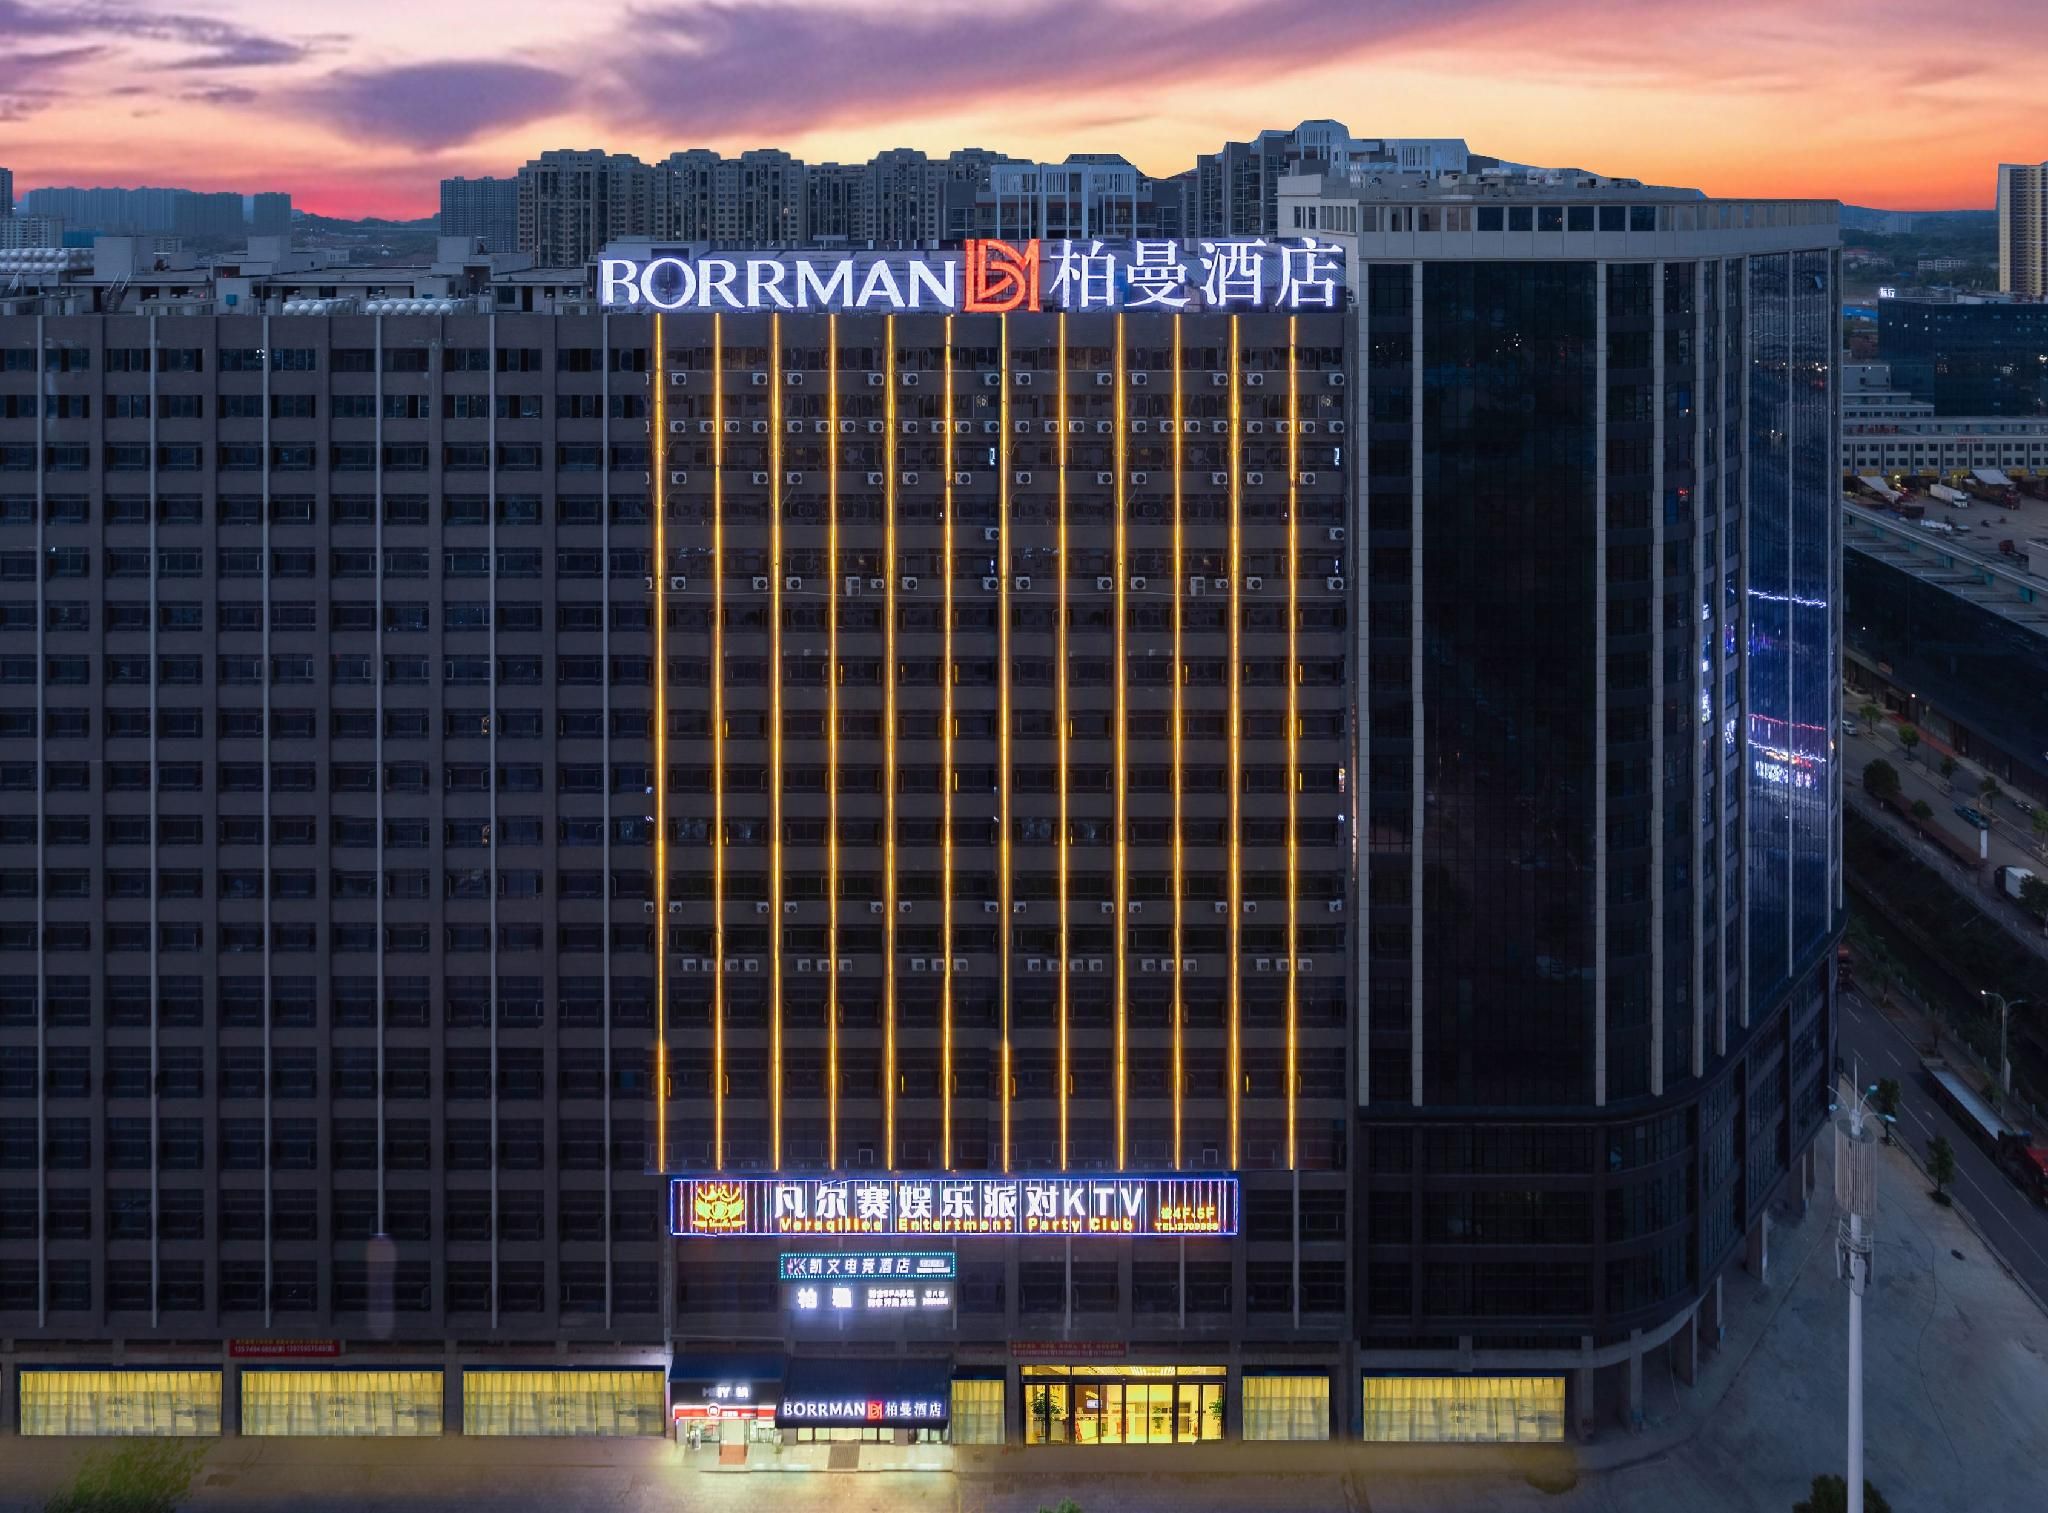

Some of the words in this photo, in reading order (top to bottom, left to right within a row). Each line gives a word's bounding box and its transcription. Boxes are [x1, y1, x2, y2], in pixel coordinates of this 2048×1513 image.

[601, 258, 955, 309] BORRMAN
[1050, 238, 1342, 309] 柏曼酒店
[775, 1186, 1144, 1218] 凡尔赛娱乐派对KTV
[1028, 1217, 1080, 1232] Party
[1090, 1217, 1133, 1231] Club
[809, 1258, 911, 1275] 凯文电竞酒店
[783, 1402, 866, 1417] BORRMAN
[885, 1402, 943, 1417] 柏曼酒店
